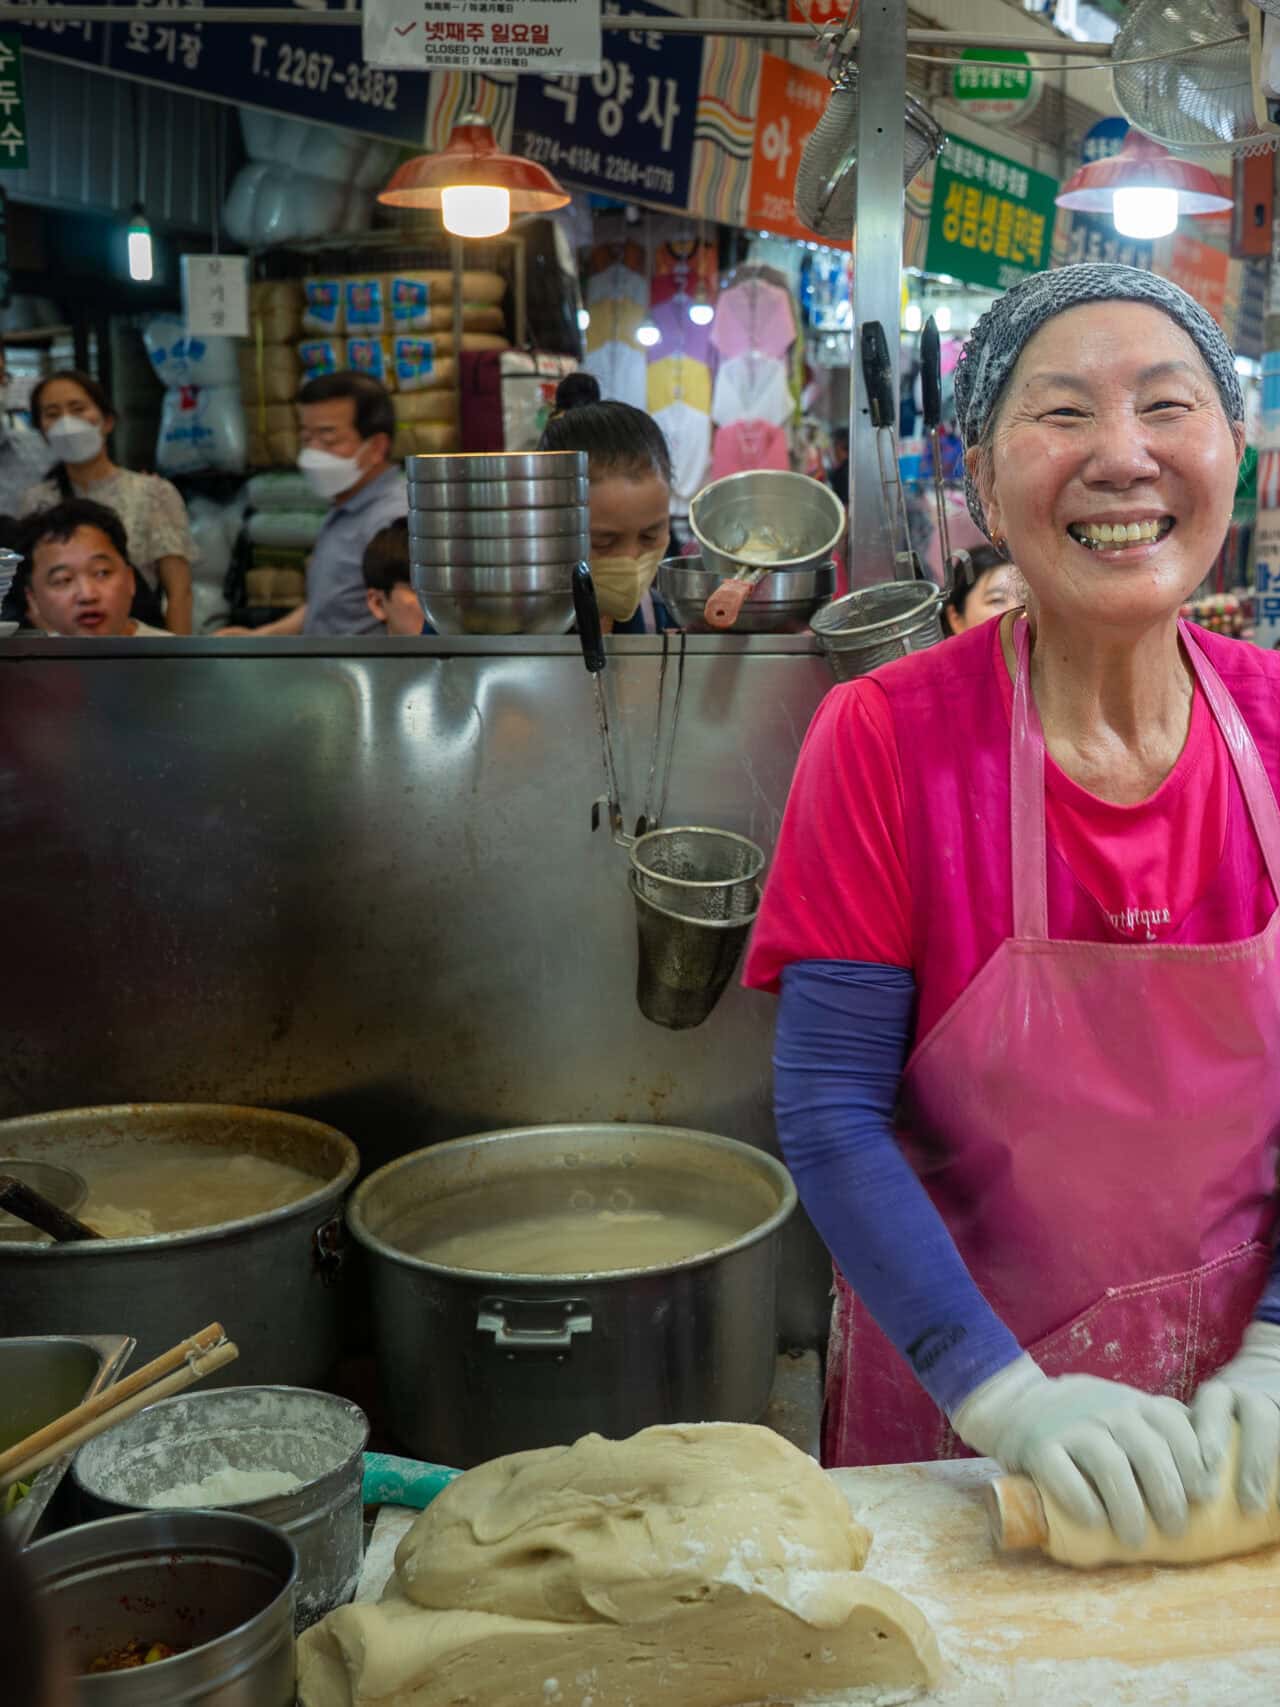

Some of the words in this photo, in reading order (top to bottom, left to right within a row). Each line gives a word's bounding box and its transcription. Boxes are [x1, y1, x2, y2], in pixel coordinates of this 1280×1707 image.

[425, 20, 485, 42] 넷째주
[491, 23, 551, 44] 일요일
[425, 44, 469, 56] CLOSED
[472, 45, 489, 56] ON
[492, 45, 514, 57] 4TH
[516, 46, 563, 58] SUNDAY
